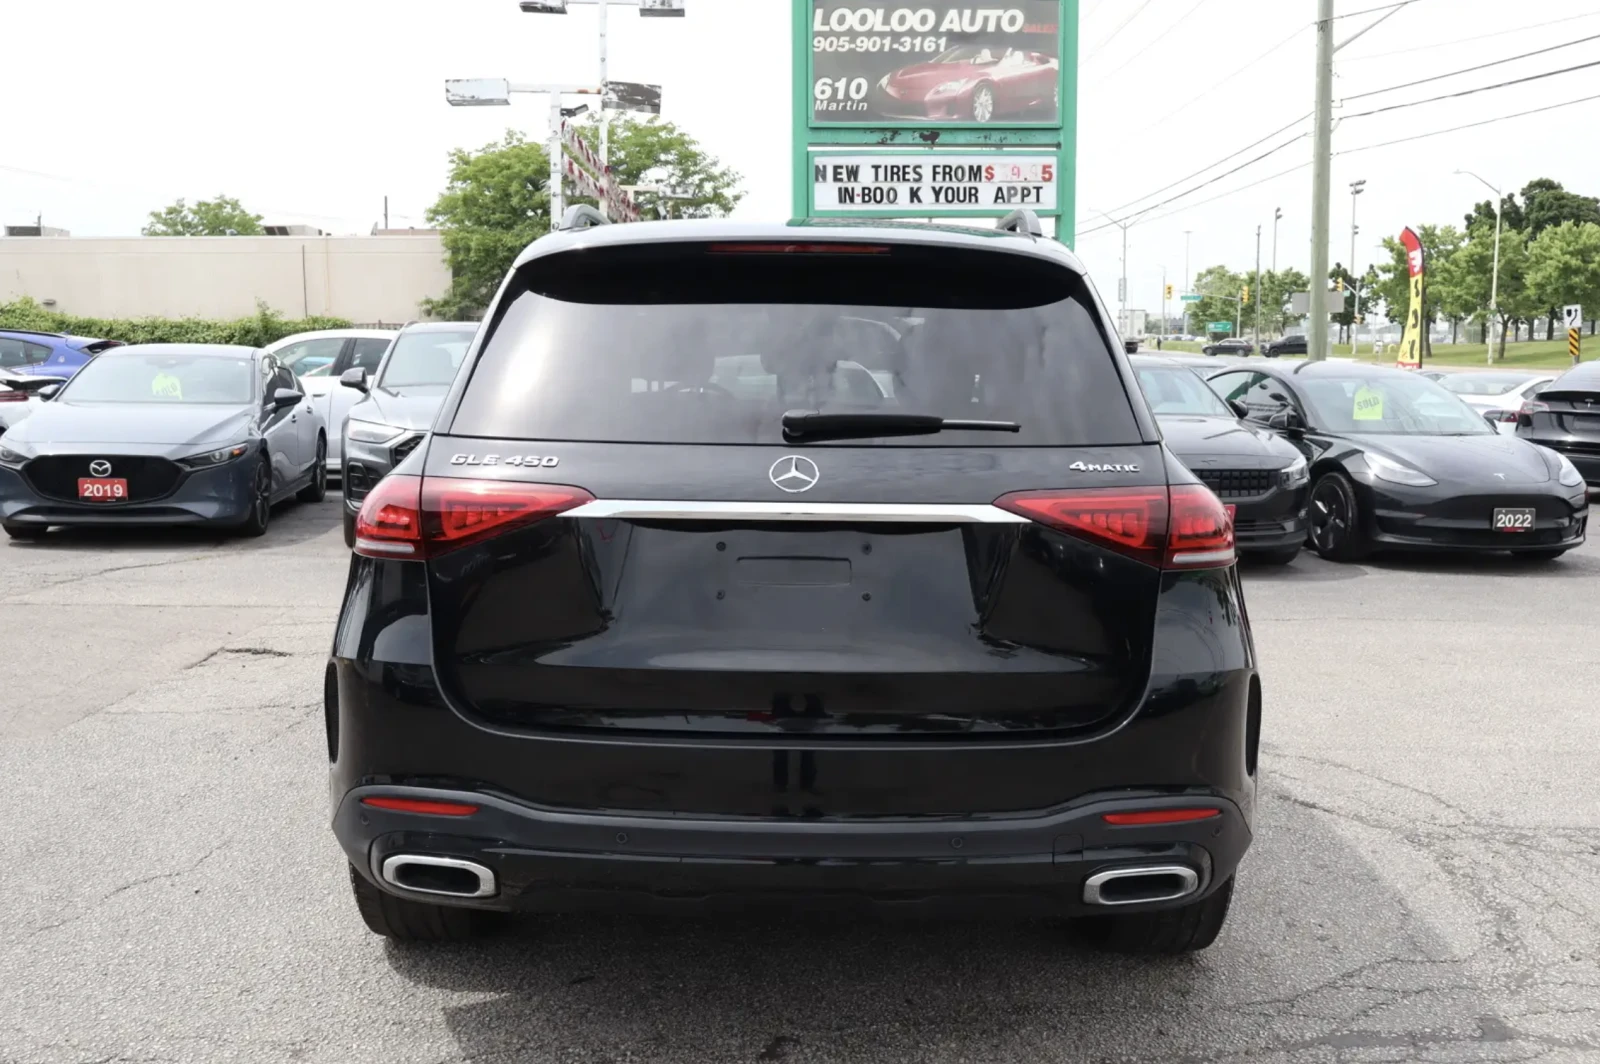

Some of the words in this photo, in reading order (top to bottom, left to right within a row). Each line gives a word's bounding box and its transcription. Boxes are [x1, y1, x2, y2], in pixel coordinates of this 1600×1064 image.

[813, 8, 936, 32] LOOLOO
[939, 8, 1025, 33] AUTO
[813, 36, 947, 52] 905-901-3161
[814, 77, 868, 100] 610
[815, 100, 868, 111] Martin
[871, 165, 923, 182] TIRES
[931, 186, 979, 204] YOUR
[993, 186, 1043, 204] APPT
[1356, 396, 1380, 411] SOLD
[450, 453, 501, 466] GLE
[504, 455, 560, 468] 450
[1069, 461, 1140, 473] 4MATIC
[83, 483, 123, 497] 2019
[1496, 514, 1532, 528] 2022
